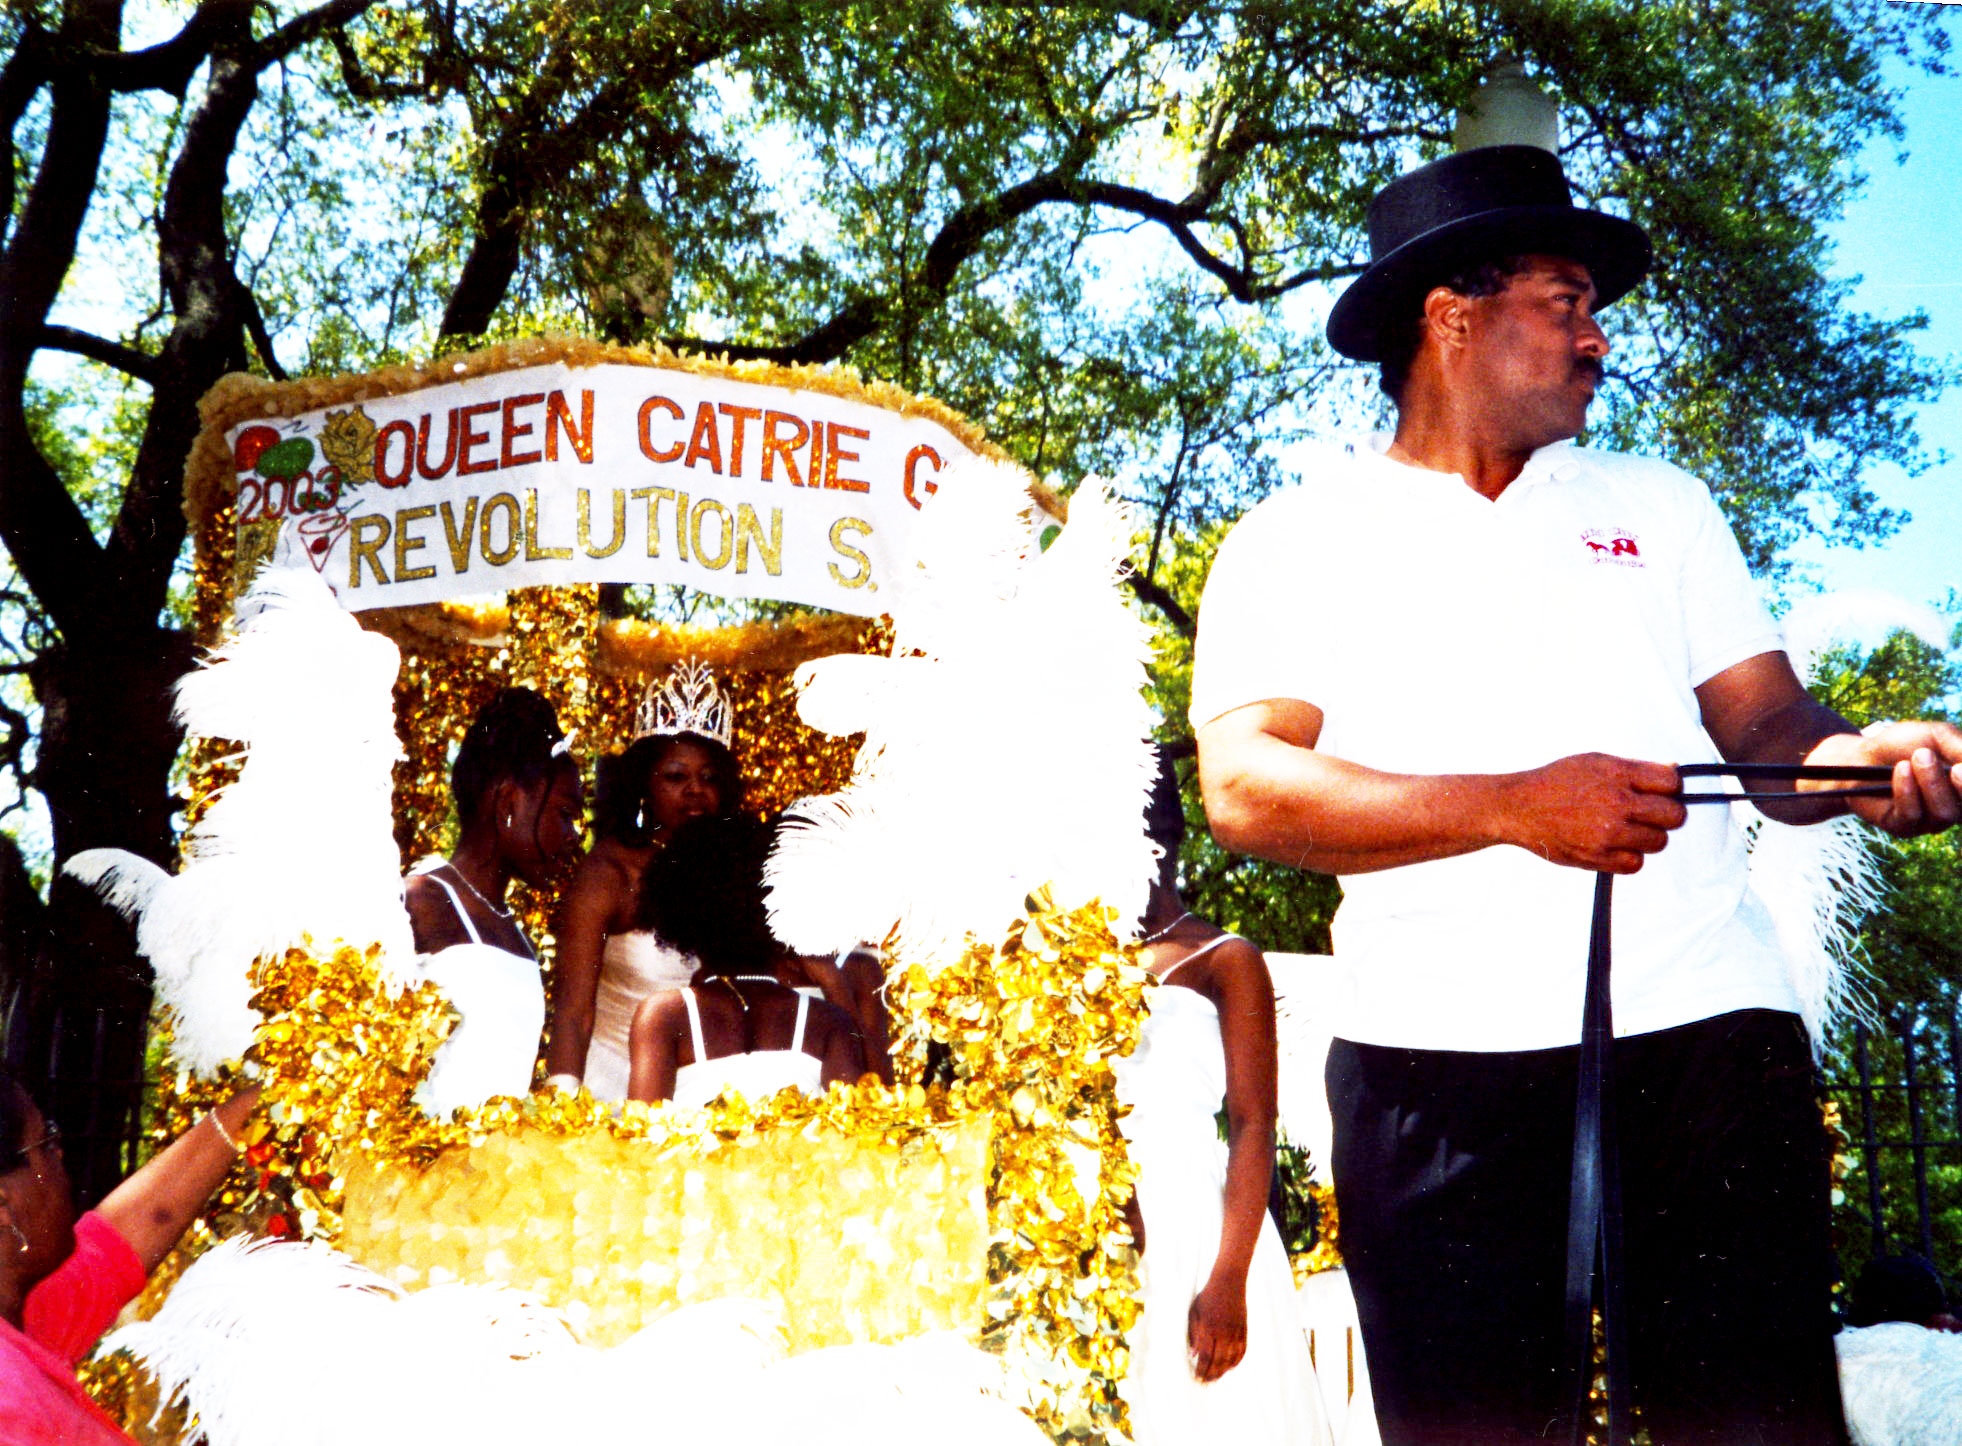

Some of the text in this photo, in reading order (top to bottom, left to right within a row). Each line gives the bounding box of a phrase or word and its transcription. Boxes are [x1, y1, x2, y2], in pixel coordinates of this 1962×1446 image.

[238, 465, 342, 526] 2003
[373, 389, 950, 512] QUEEN CATRIE G
[348, 486, 879, 593] REVOLUTION S.
